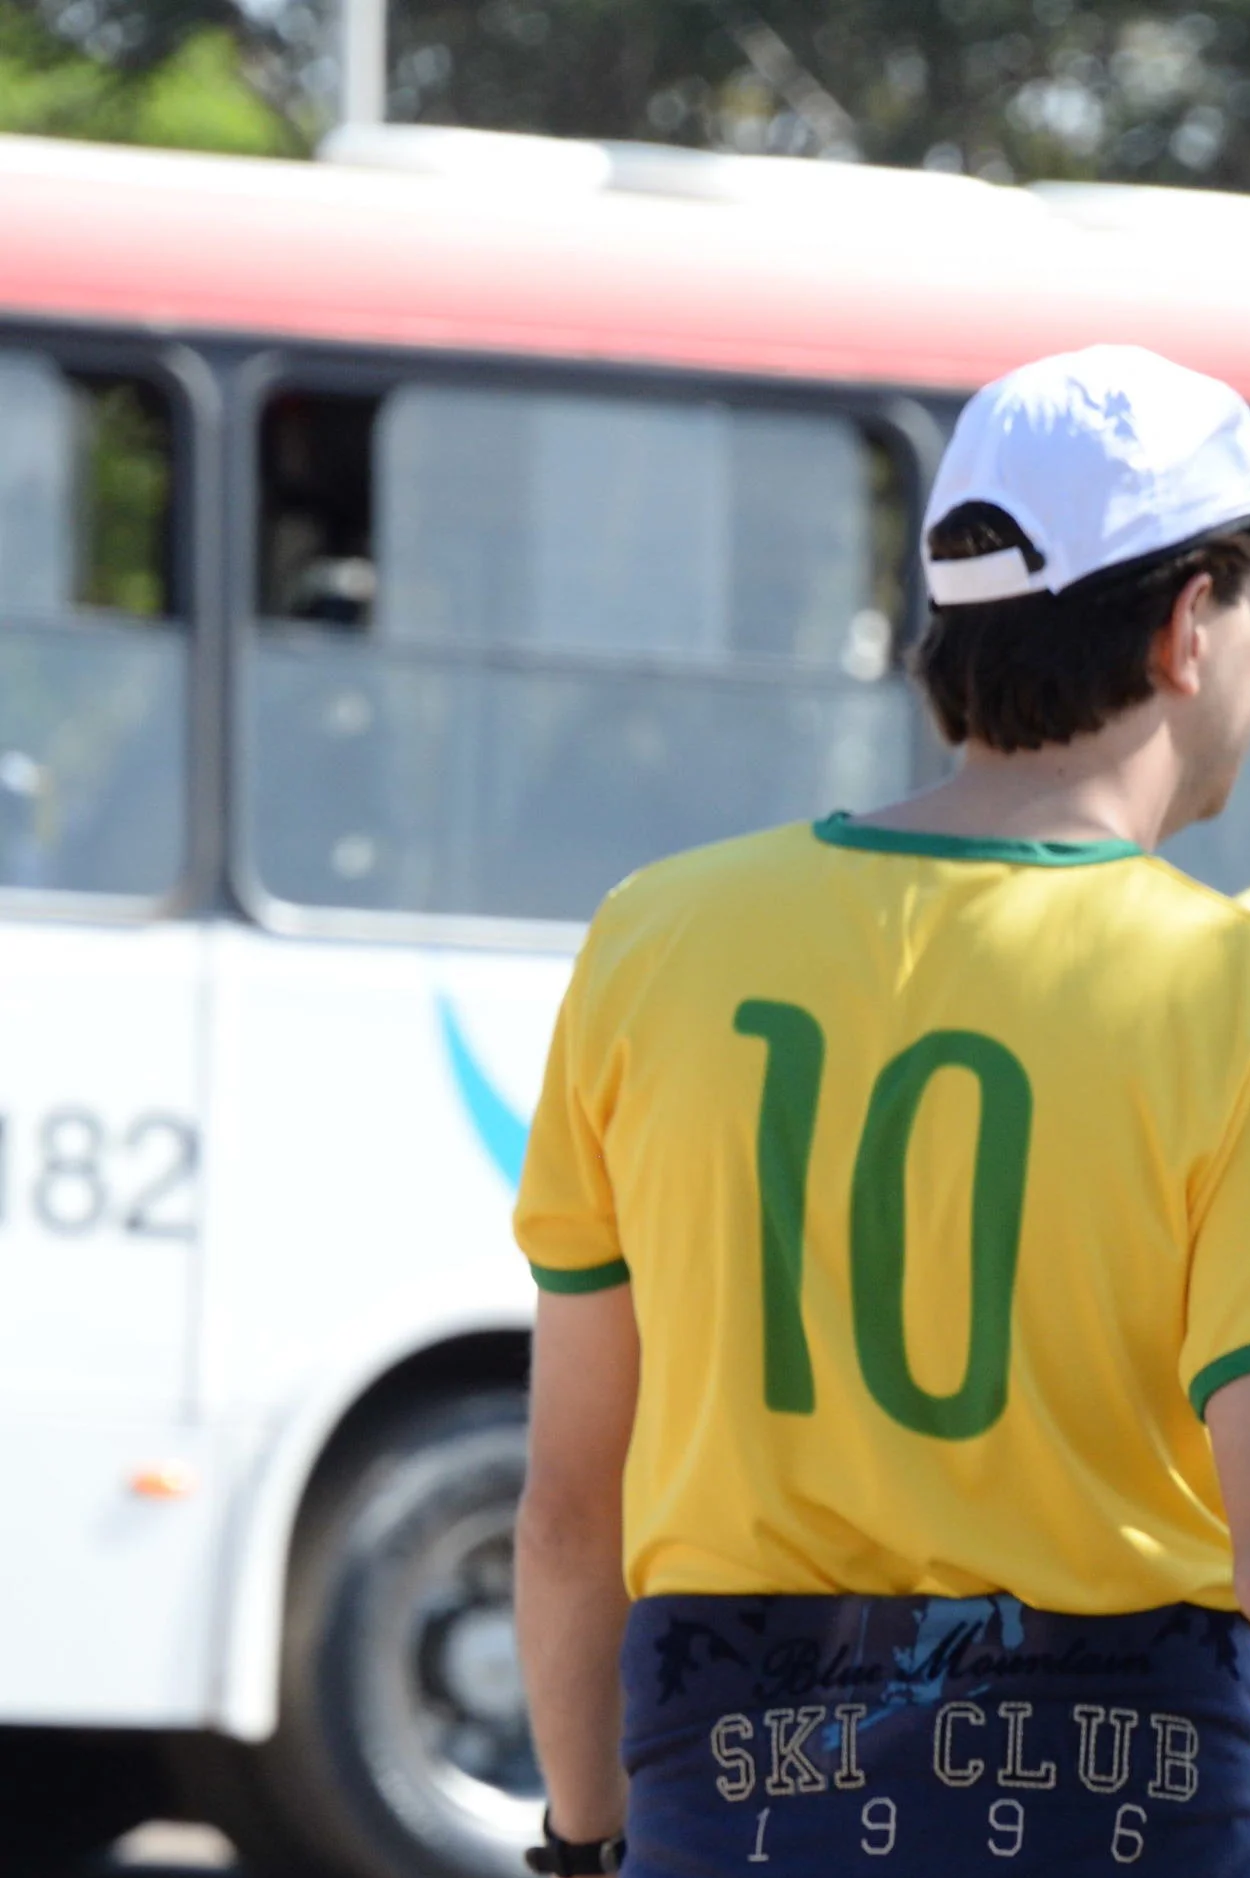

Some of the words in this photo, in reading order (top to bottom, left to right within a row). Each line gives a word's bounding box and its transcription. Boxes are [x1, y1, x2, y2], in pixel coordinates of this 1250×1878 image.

[732, 998, 1035, 1442] 10
[755, 1634, 882, 1699] Blue
[898, 1620, 1152, 1686] Mountain
[710, 1703, 867, 1802] SKI
[932, 1701, 1200, 1803] CLUB
